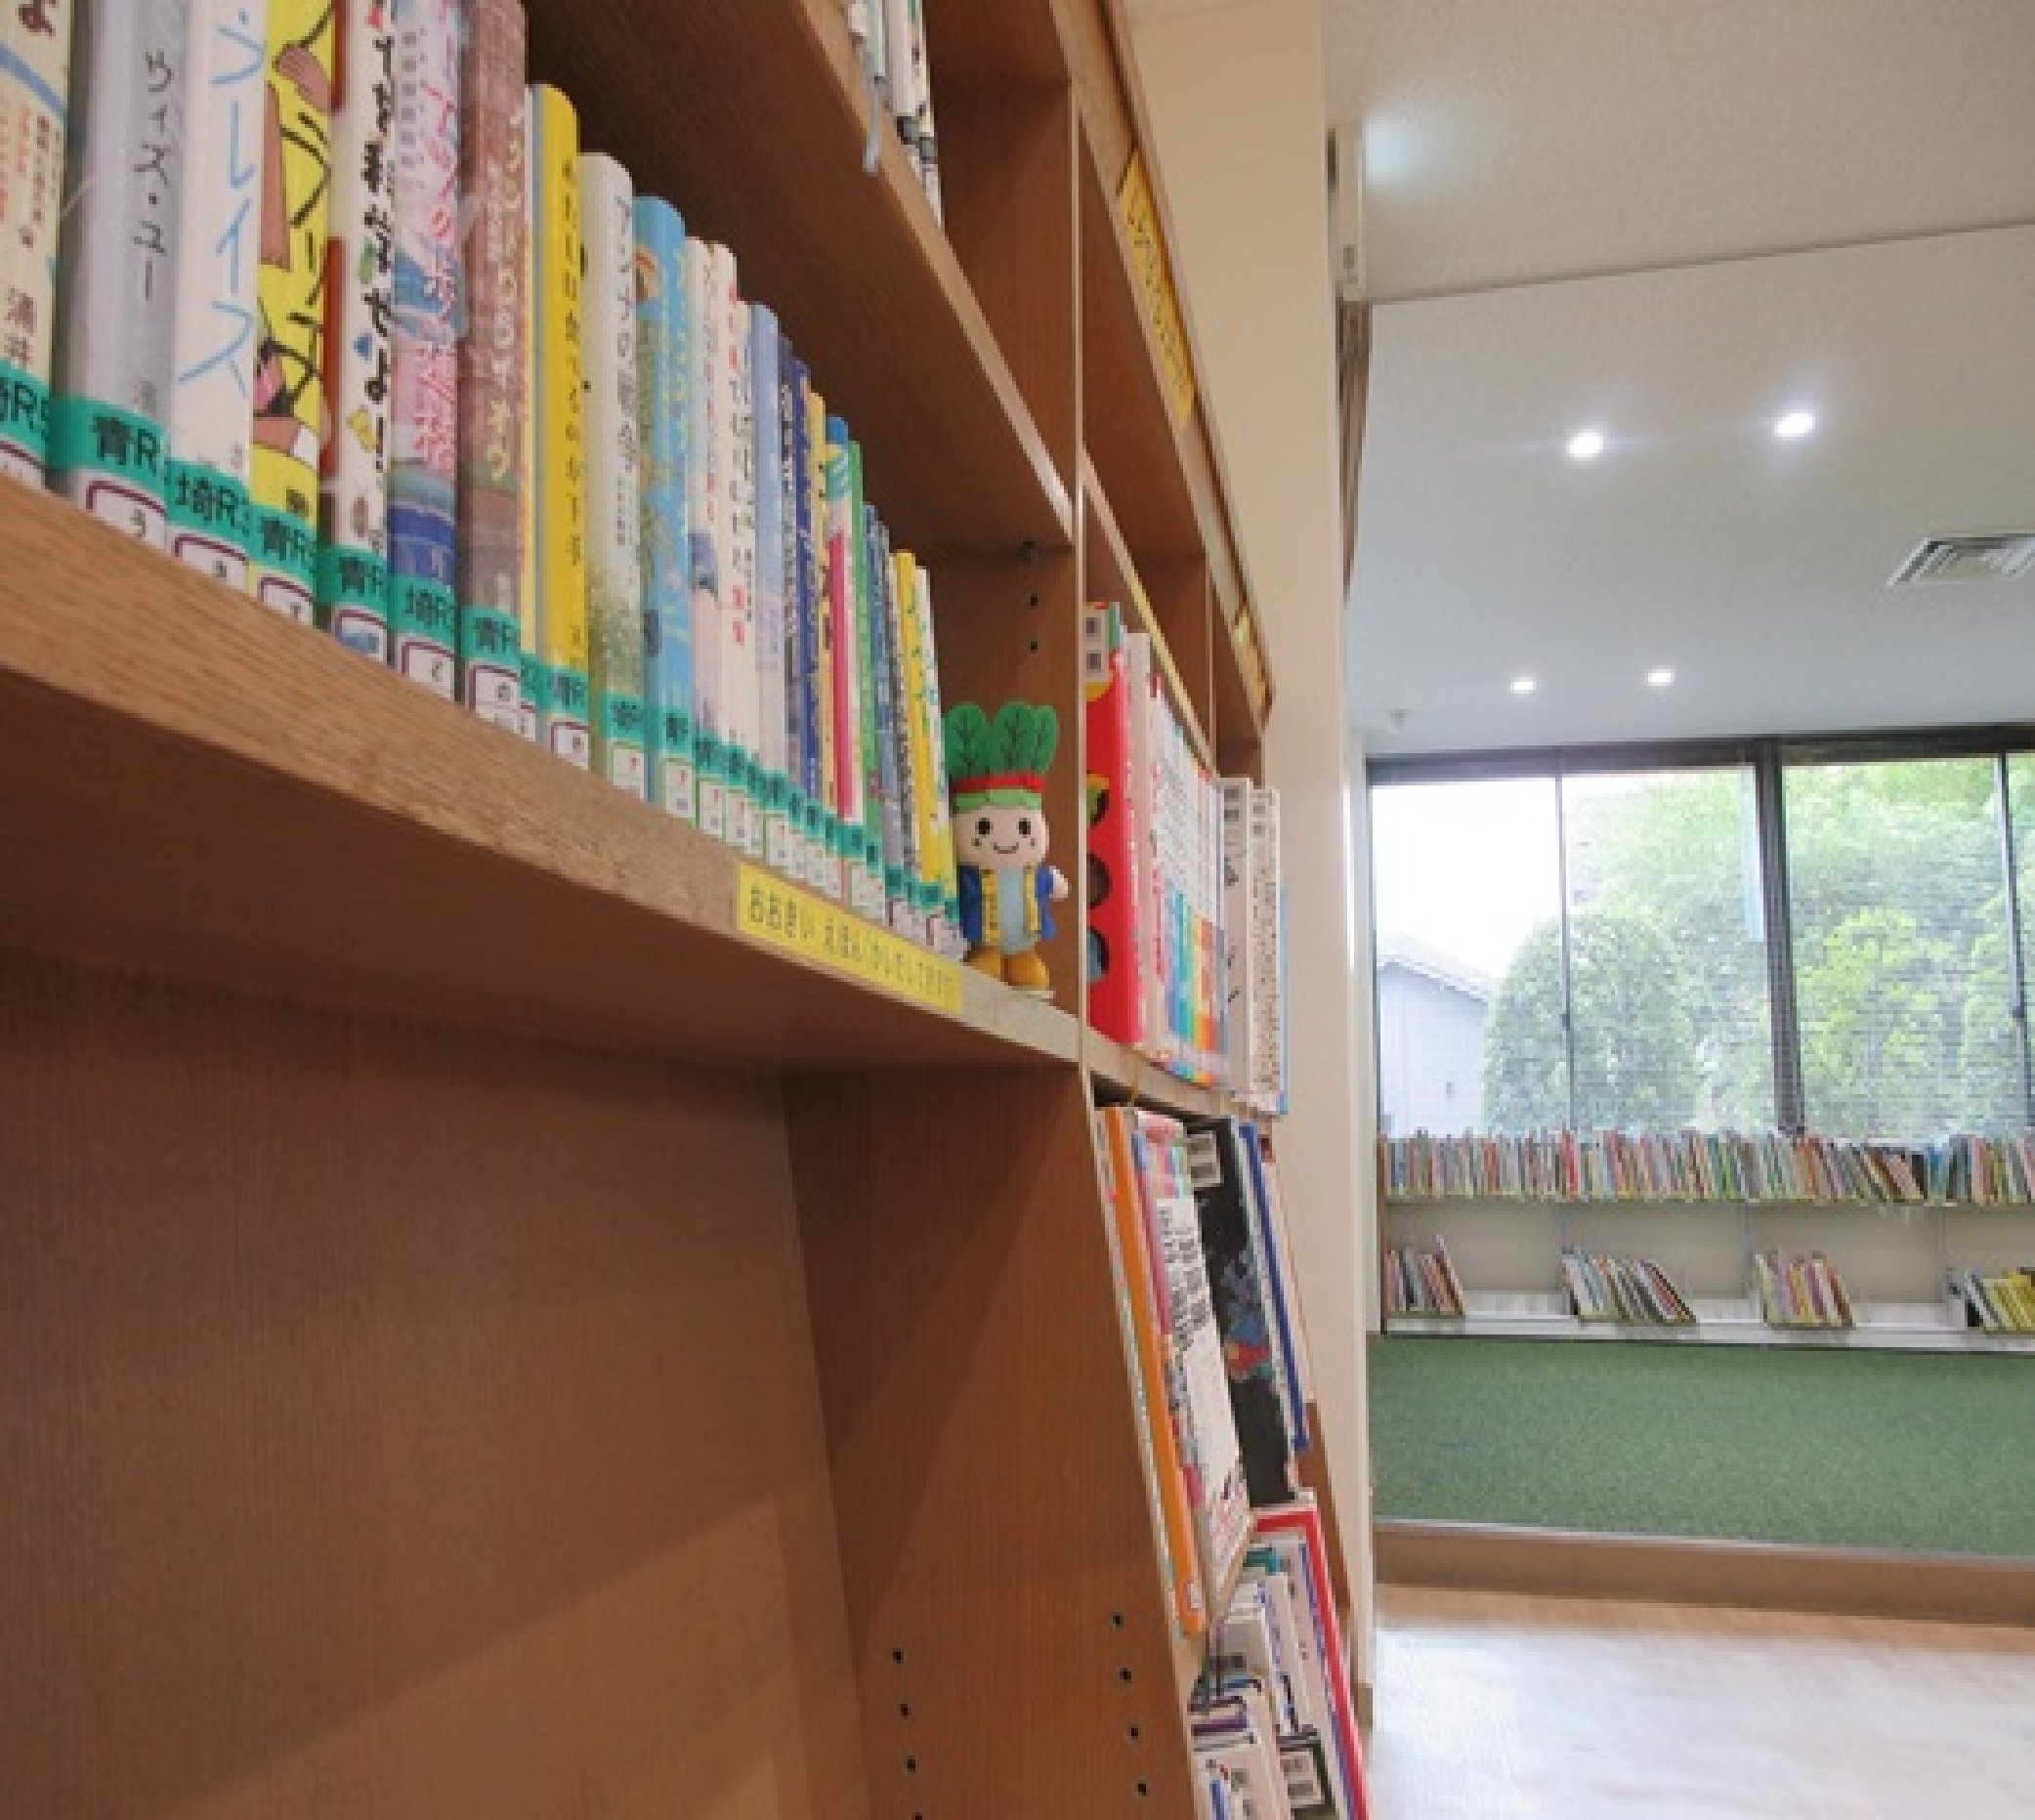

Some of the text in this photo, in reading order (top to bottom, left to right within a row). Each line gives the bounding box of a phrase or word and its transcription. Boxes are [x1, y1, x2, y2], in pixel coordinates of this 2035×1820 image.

[133, 50, 173, 301] ウィズ・ユー
